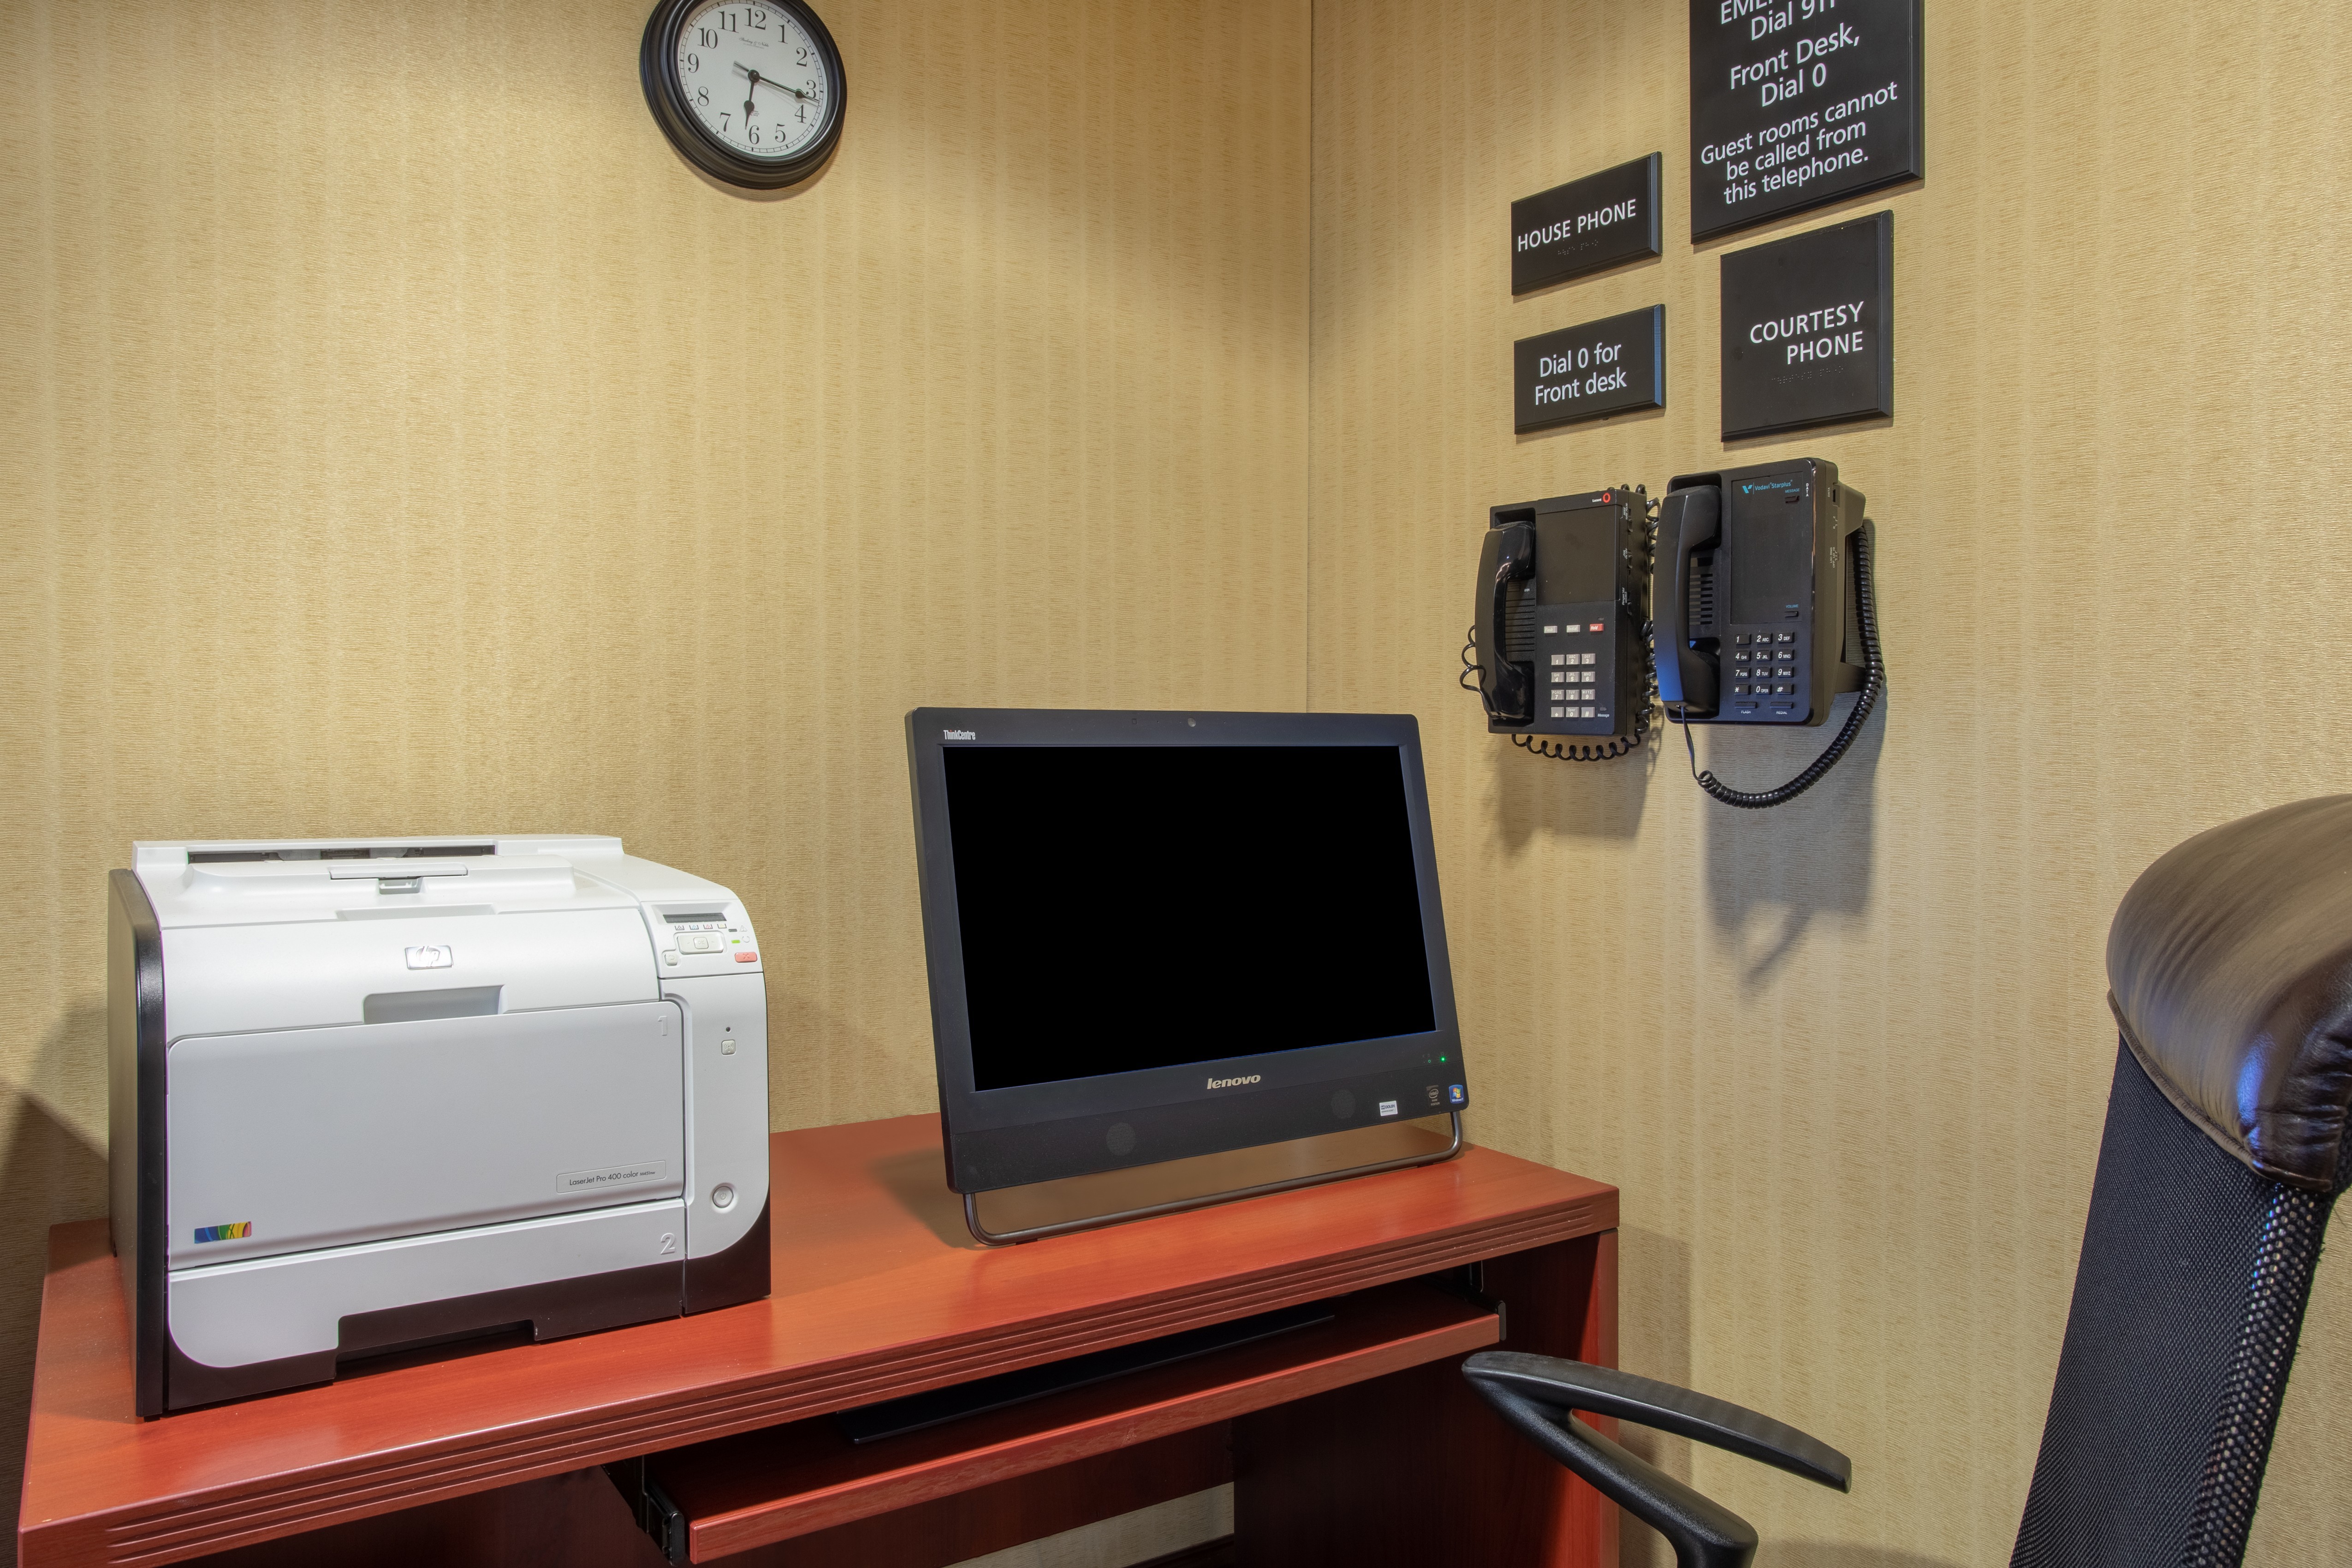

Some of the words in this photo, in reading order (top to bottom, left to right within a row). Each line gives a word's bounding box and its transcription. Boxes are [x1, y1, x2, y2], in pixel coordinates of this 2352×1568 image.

[718, 11, 739, 33] 11
[744, 8, 766, 30] 12
[1752, 1, 1792, 41] Dial
[697, 27, 719, 48] 10
[778, 24, 788, 44] 1
[687, 53, 699, 73] 9
[796, 47, 808, 67] 2
[1730, 49, 1788, 90] Front
[1797, 22, 1859, 64] Desk,
[806, 80, 816, 99] 3
[1761, 69, 1803, 107] Dial
[1812, 63, 1826, 87] 0
[697, 86, 709, 106] 8
[719, 112, 731, 132] 7
[794, 105, 807, 124] 4
[1701, 133, 1753, 164] Guest
[1759, 112, 1818, 146] rooms
[1825, 81, 1898, 122] cannot
[748, 125, 760, 144] 6
[775, 123, 786, 143] 5
[1727, 161, 1749, 181] be
[1755, 134, 1809, 171] called
[1816, 121, 1866, 150] from
[1723, 179, 1757, 204] this
[1761, 148, 1868, 192] telephone.
[1518, 220, 1571, 252] HOUSE
[1578, 198, 1636, 233] PHONE
[1750, 301, 1864, 344] COURTESY
[1787, 330, 1863, 365] PHONE
[1540, 350, 1571, 378] Dial
[1578, 348, 1589, 368] 0
[1594, 342, 1621, 365] for
[1535, 379, 1580, 405] Front
[1586, 367, 1627, 395] desk
[943, 730, 976, 740] ThinkCentre
[658, 1016, 667, 1036] 1
[1207, 1075, 1261, 1089] lenovo
[570, 1177, 594, 1186] LaserJet
[660, 1233, 676, 1255] 2
